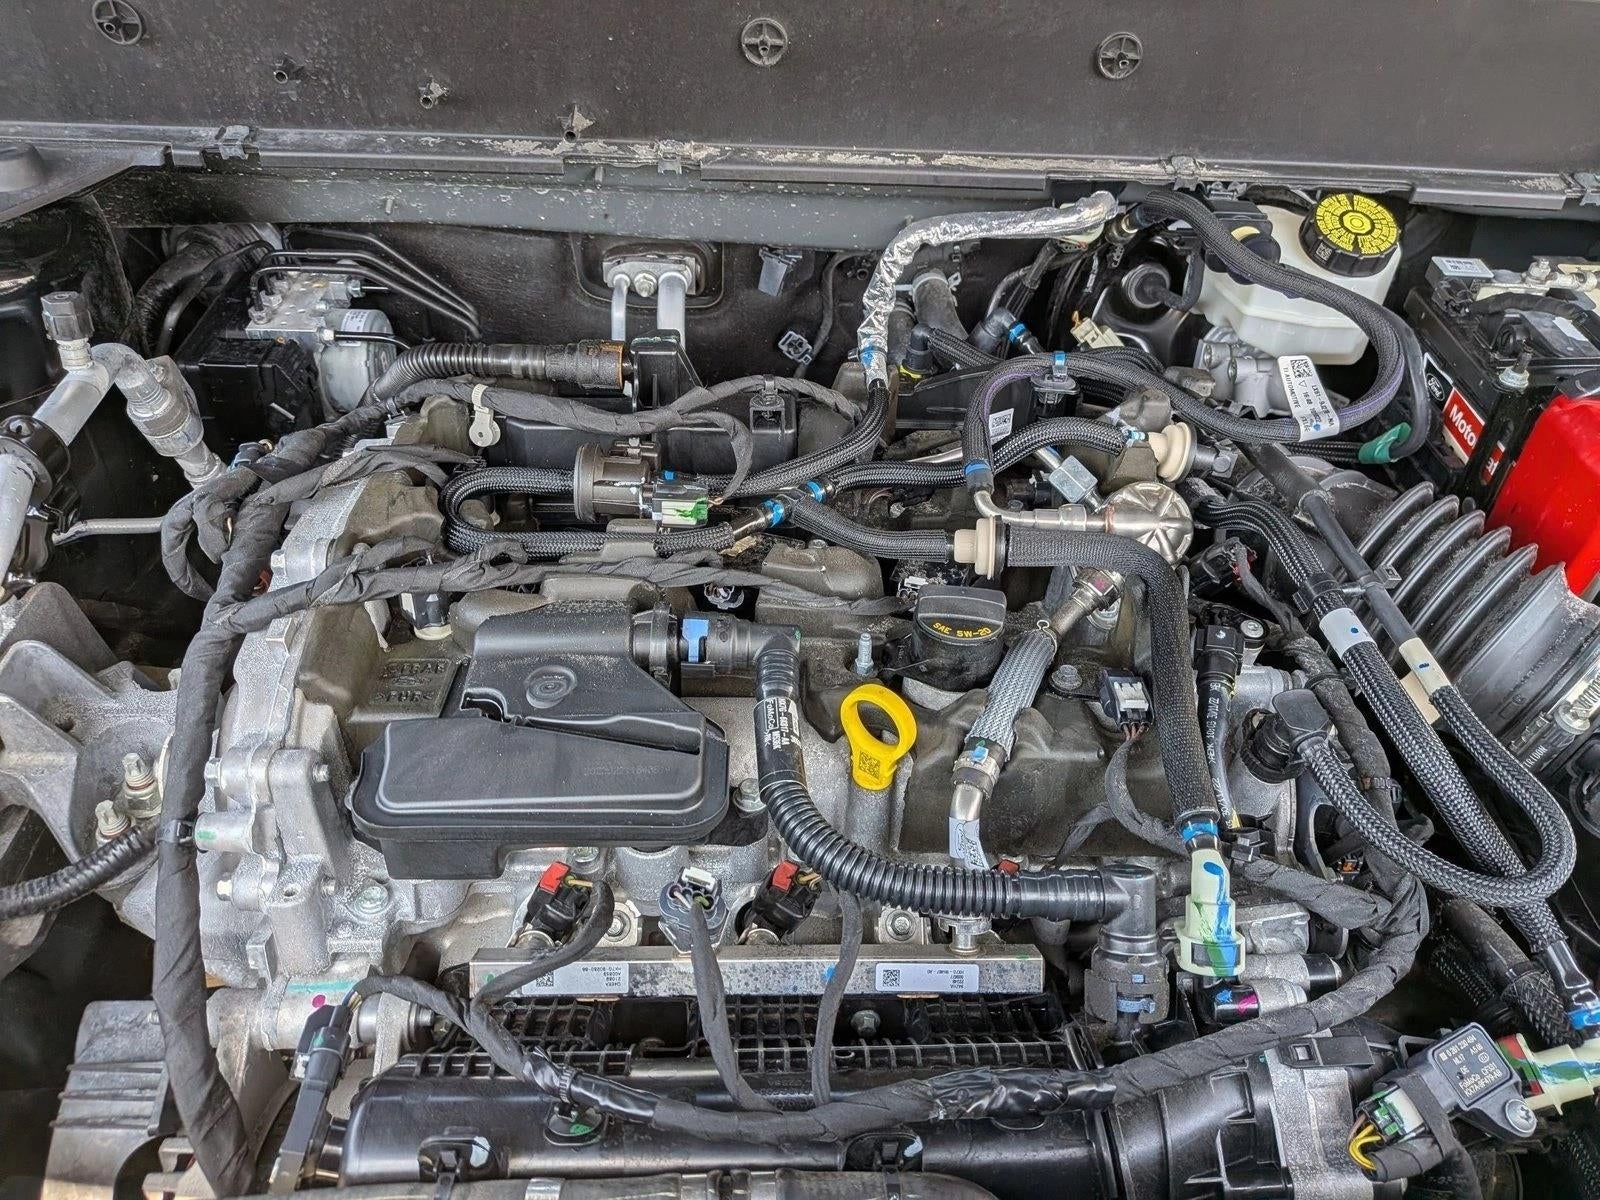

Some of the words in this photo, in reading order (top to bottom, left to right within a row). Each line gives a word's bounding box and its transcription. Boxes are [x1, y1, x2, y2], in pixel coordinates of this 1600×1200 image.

[1284, 374, 1301, 408] AUTOMOTIVE
[933, 622, 952, 635] SAE
[956, 627, 992, 638] 5W-20
[766, 699, 775, 730] FoMoCo
